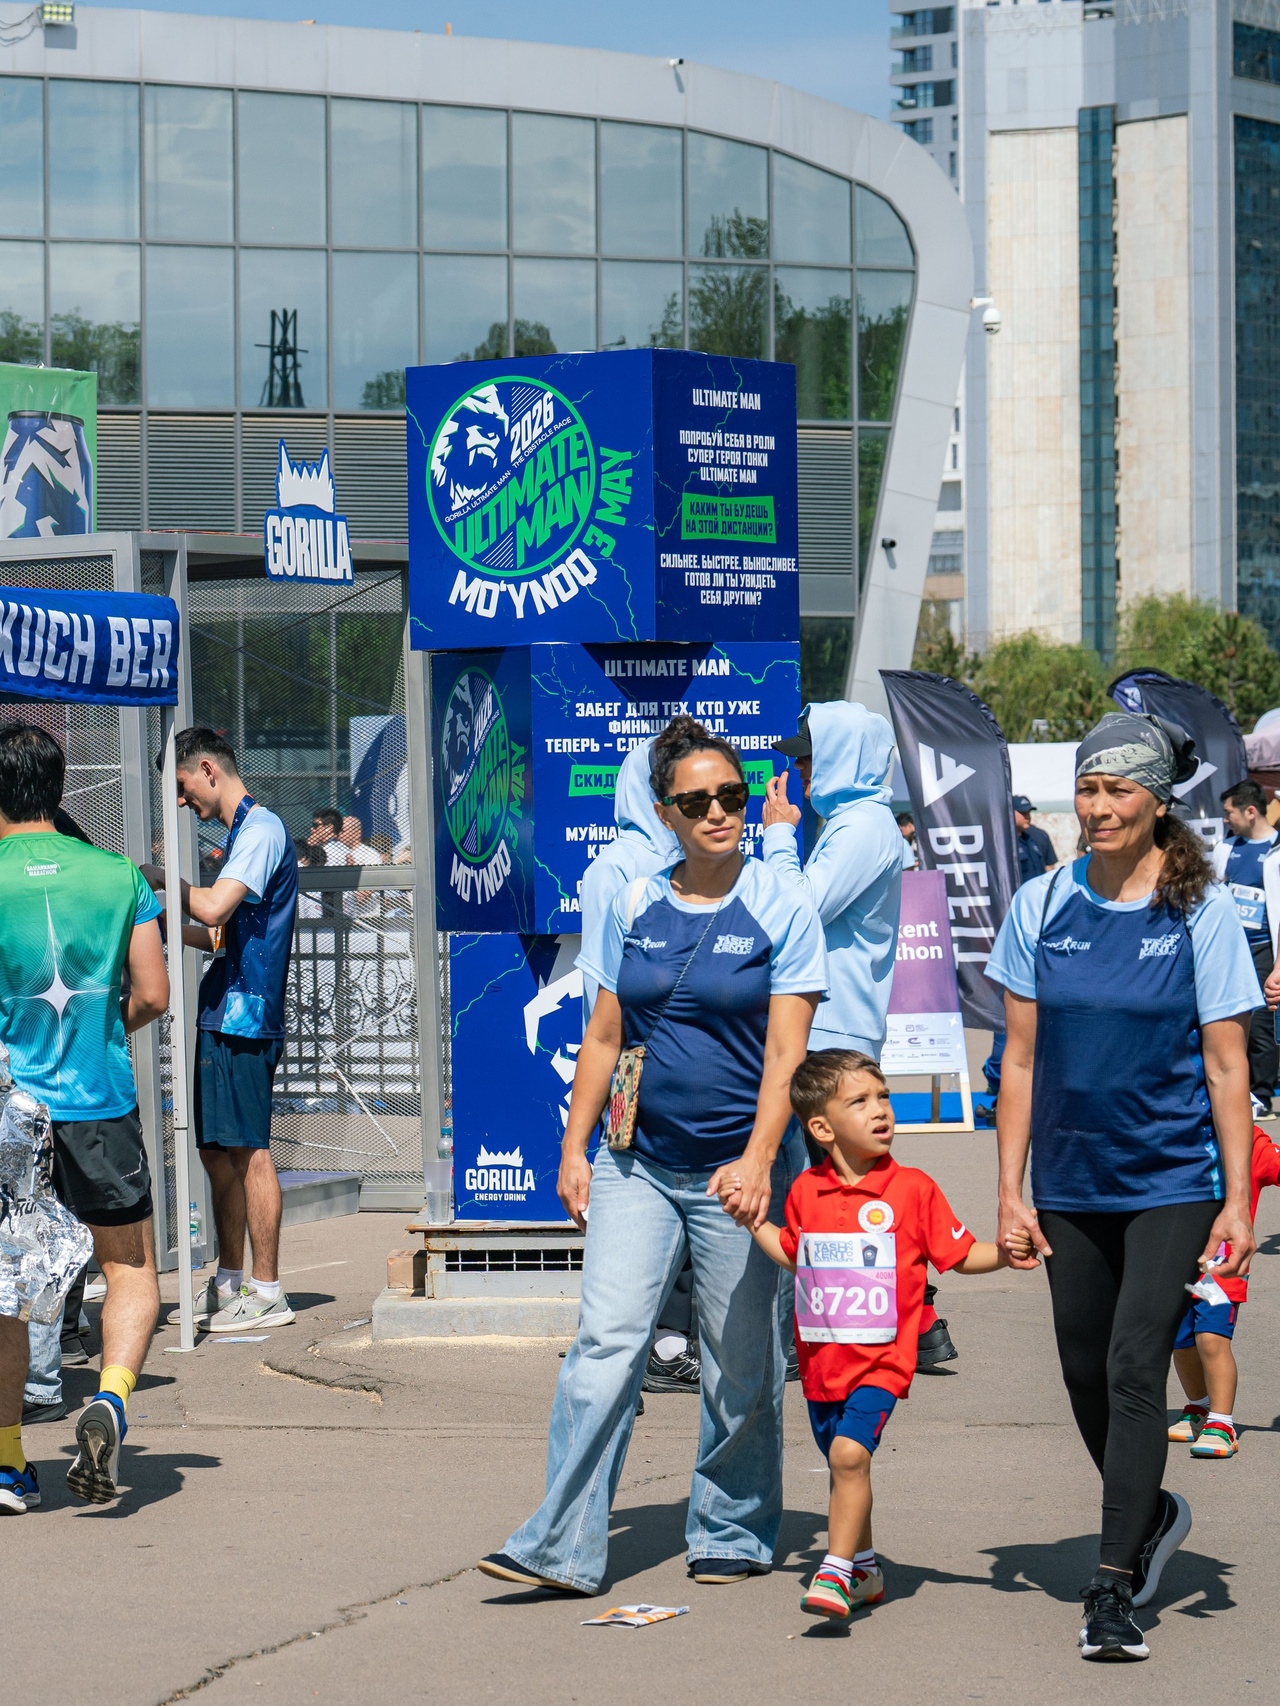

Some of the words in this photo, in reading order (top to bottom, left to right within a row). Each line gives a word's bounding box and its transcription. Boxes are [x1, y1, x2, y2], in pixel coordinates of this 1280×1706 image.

[692, 388, 738, 409] ULTIMATE
[739, 392, 761, 411] MAN
[510, 390, 555, 463] 2026
[679, 429, 723, 447] ПОПРОБУЙ
[724, 433, 745, 448] СЕБЯ
[746, 435, 752, 449] В
[753, 435, 775, 450] РОЛИ
[687, 448, 714, 463] СУПЕР
[715, 450, 741, 466] ГЕРОЯ
[742, 451, 768, 467] ГОНКИ
[444, 505, 472, 523] GORILLA
[470, 481, 498, 508] ULTIMATE
[512, 455, 525, 469] THE
[523, 429, 554, 458] OBSTACLE
[553, 416, 572, 432] RACE
[700, 466, 738, 483] ULTIMATE
[739, 469, 757, 484] MAN
[455, 423, 588, 560] ULTIMATE
[594, 446, 633, 526] MAY
[516, 470, 590, 569] MAN
[689, 501, 718, 517] КАКИМ
[720, 502, 732, 517] ТЫ
[734, 504, 768, 519] БУДЕШЬ
[685, 519, 697, 533] НА
[698, 518, 719, 534] ЭТОЙ
[720, 520, 773, 537] ДИСТАНЦИИ?
[266, 515, 353, 580] GORILLA
[582, 524, 616, 558] 3
[660, 553, 700, 569] СИЛЬНЕЕ.
[701, 554, 742, 570] БЫСТРЕЕ.
[742, 556, 798, 572] ВЫНОСЛИВЕЕ.
[685, 572, 711, 587] ГОТОВ
[712, 573, 724, 588] ЛИ
[725, 573, 738, 588] ТЫ
[739, 574, 776, 589] УВИДЕТЬ
[700, 590, 721, 605] СЕБЯ
[722, 591, 761, 606] ДРУГИМ?
[106, 616, 173, 689] BER
[604, 658, 687, 677] ULTIMATE
[692, 658, 730, 676] MAN
[473, 683, 493, 751] 2026
[575, 702, 621, 717] ЗАБЕГ
[625, 702, 658, 719] ДЛЯ
[661, 700, 693, 718] ТЕХ,
[696, 700, 723, 716] КТО
[727, 700, 761, 716] УЖЕ
[545, 738, 600, 753] ТЕПЕРЬ
[451, 721, 508, 842] ULTIMATE
[508, 740, 526, 819] MAY
[477, 763, 508, 856] MAN
[504, 817, 519, 850] 3
[1070, 941, 1092, 950] RUN
[465, 1168, 536, 1191] GORILLA
[474, 1193, 503, 1201] ENERGY
[503, 1193, 526, 1201] DRINK
[814, 1241, 848, 1252] TASH
[814, 1250, 846, 1259] KENT
[875, 1271, 894, 1280] 400M
[810, 1286, 889, 1316] 8720
